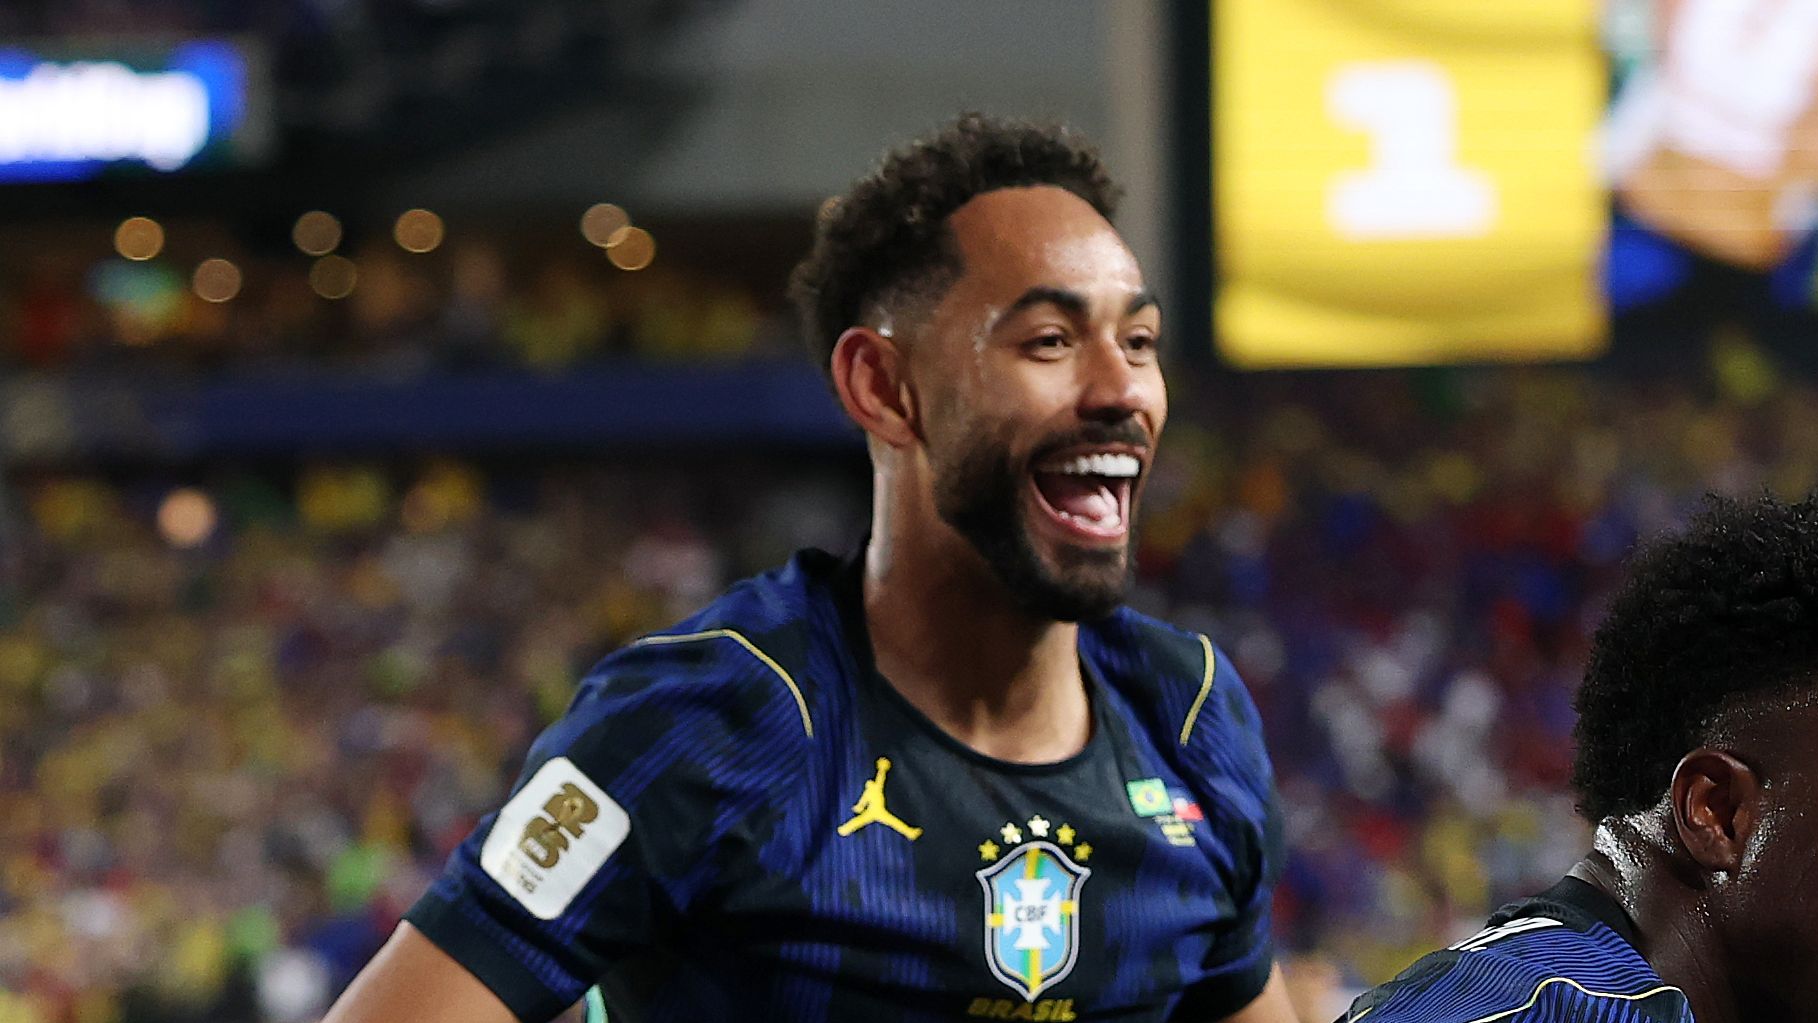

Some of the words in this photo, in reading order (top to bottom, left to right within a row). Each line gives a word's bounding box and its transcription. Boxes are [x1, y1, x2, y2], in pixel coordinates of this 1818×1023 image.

[1325, 57, 1497, 241] 1
[1014, 903, 1049, 923] CBF
[967, 997, 1078, 1023] BRASIL
